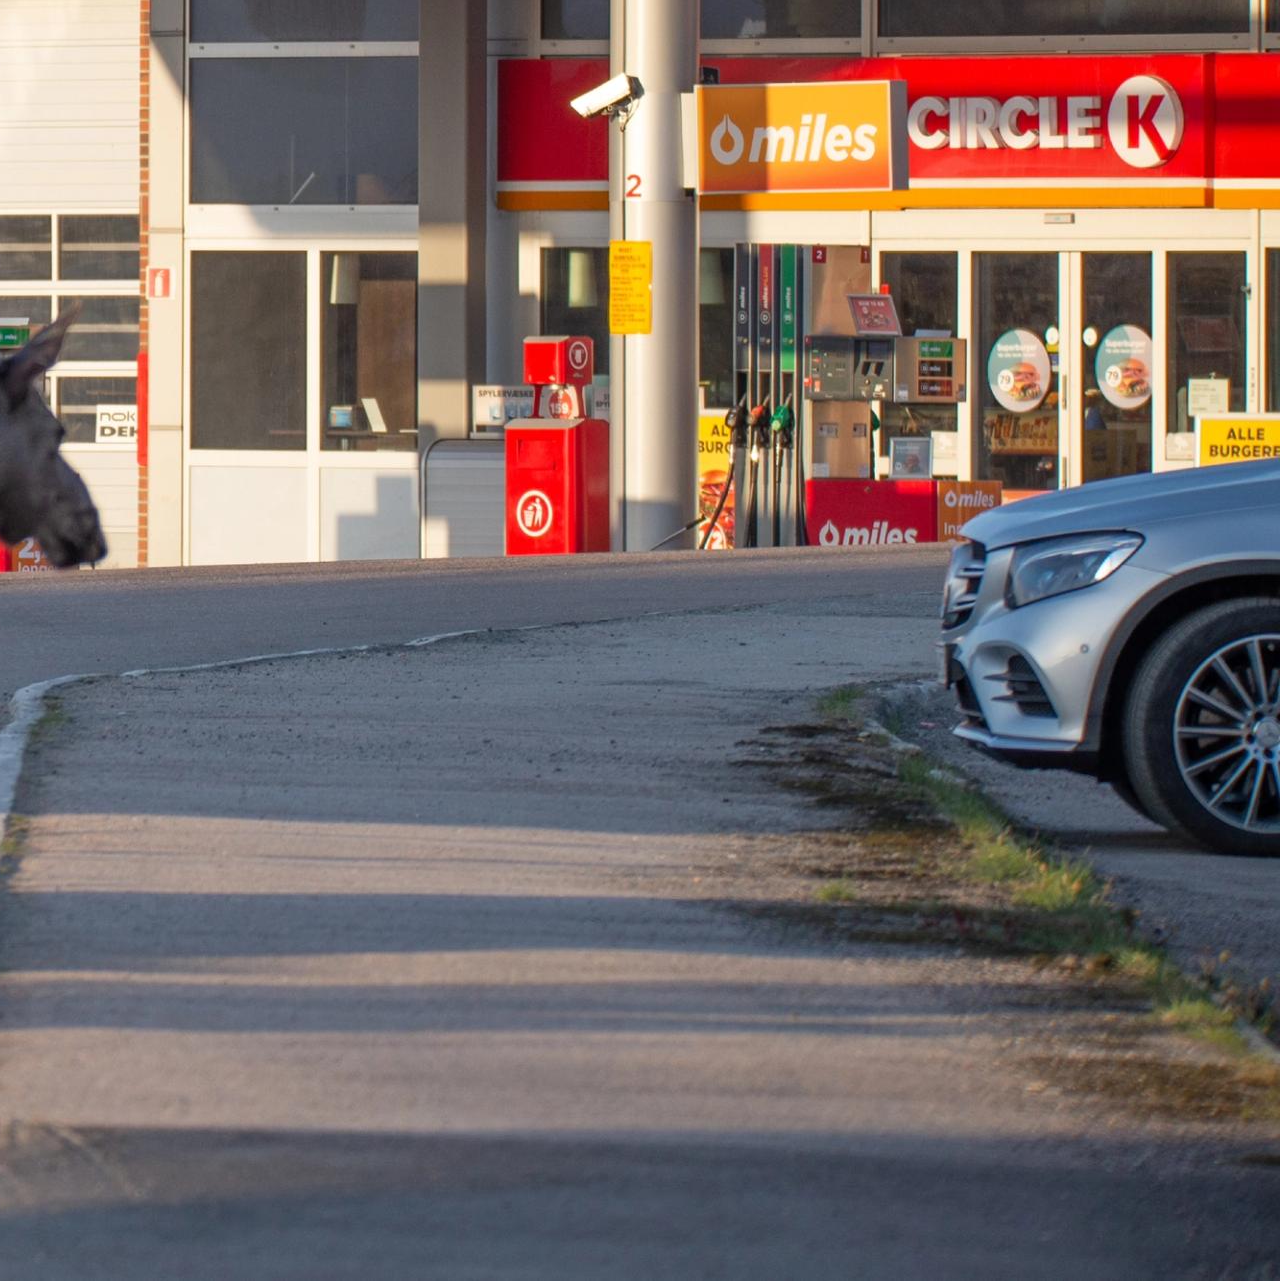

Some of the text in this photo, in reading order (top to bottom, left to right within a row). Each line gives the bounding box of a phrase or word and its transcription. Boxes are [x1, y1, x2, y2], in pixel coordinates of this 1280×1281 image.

[907, 83, 1181, 165] CIRCLE K
[748, 113, 878, 163] miles
[625, 174, 642, 198] 2
[816, 250, 823, 260] 2
[550, 403, 568, 415] 159
[1227, 428, 1265, 440] ALLE
[1209, 445, 1280, 457] BURGERE
[958, 490, 995, 508] miles
[843, 521, 918, 545] miles
